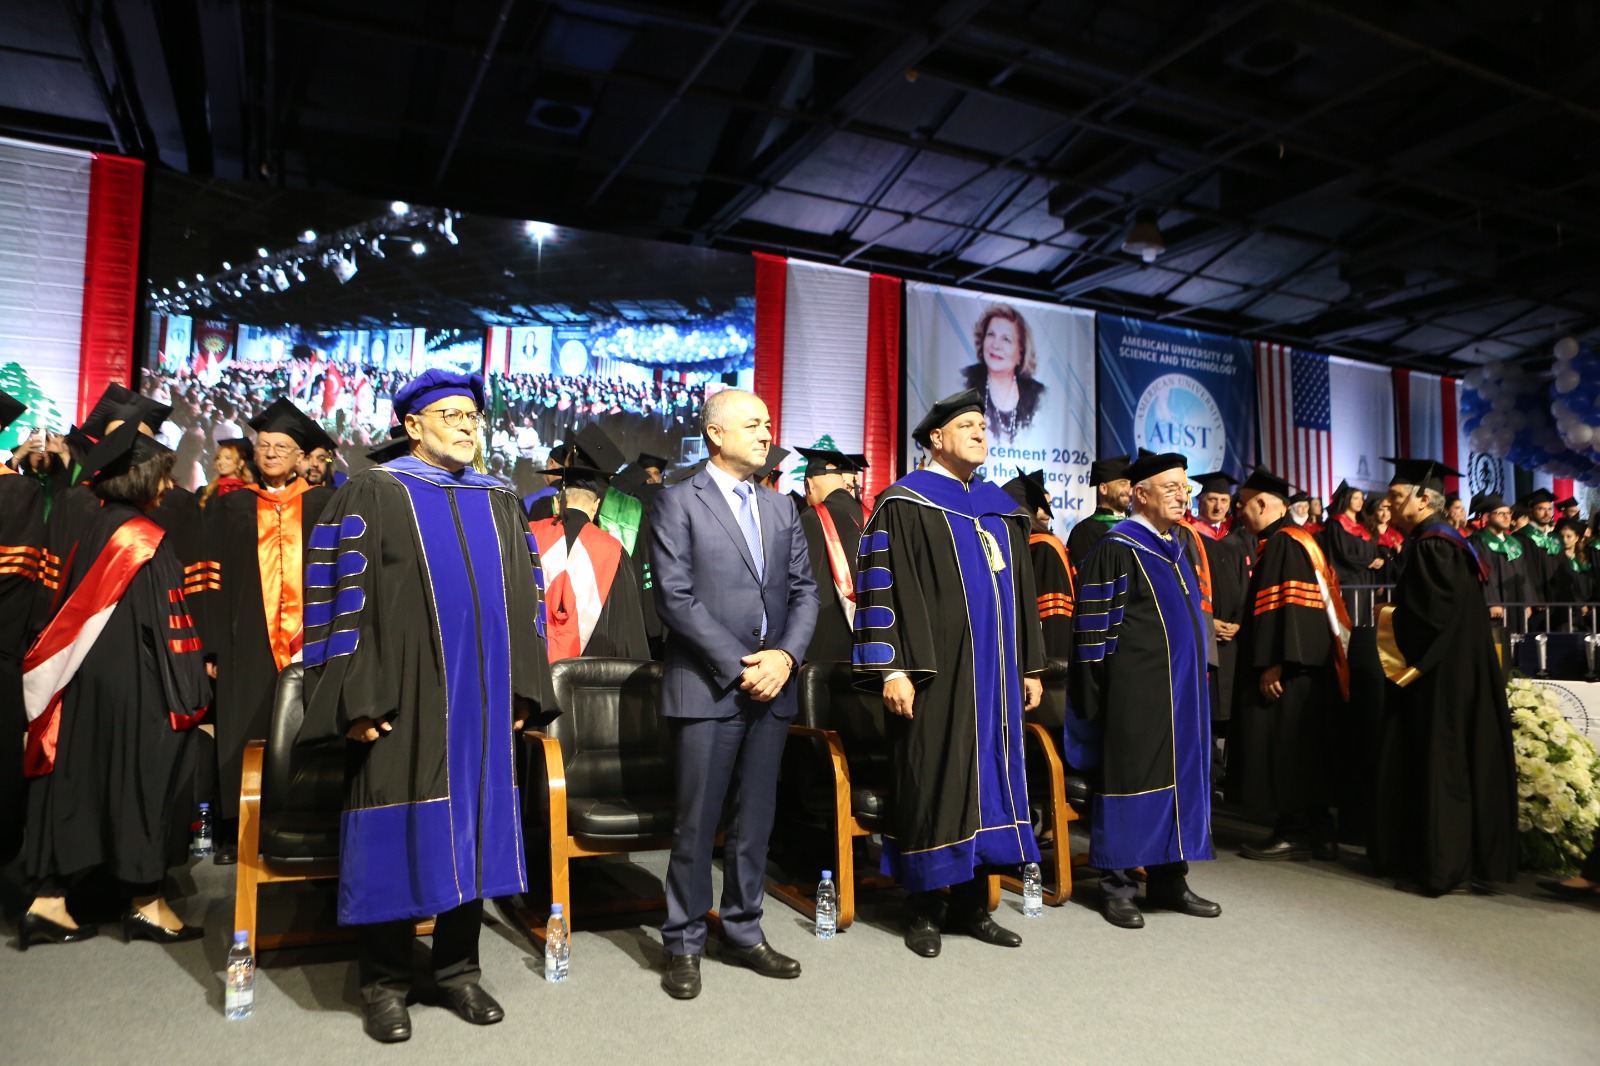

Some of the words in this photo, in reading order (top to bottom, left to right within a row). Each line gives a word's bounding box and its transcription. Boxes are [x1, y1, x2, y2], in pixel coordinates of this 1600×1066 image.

[1119, 346, 1158, 363] SCIENCE
[1159, 355, 1179, 366] AND
[1181, 357, 1238, 376] TECHNOLOGY
[1121, 335, 1170, 353] AMERICAN
[1171, 343, 1222, 362] UNIVERSITY
[1222, 353, 1235, 364] OF
[1137, 377, 1175, 420] AMERICAN
[1178, 378, 1223, 431] UNIVERSITY
[1149, 421, 1212, 449] AUST
[1052, 448, 1089, 466] 2026
[993, 462, 1017, 478] the
[1078, 471, 1091, 484] of
[1051, 490, 1084, 510] akr
